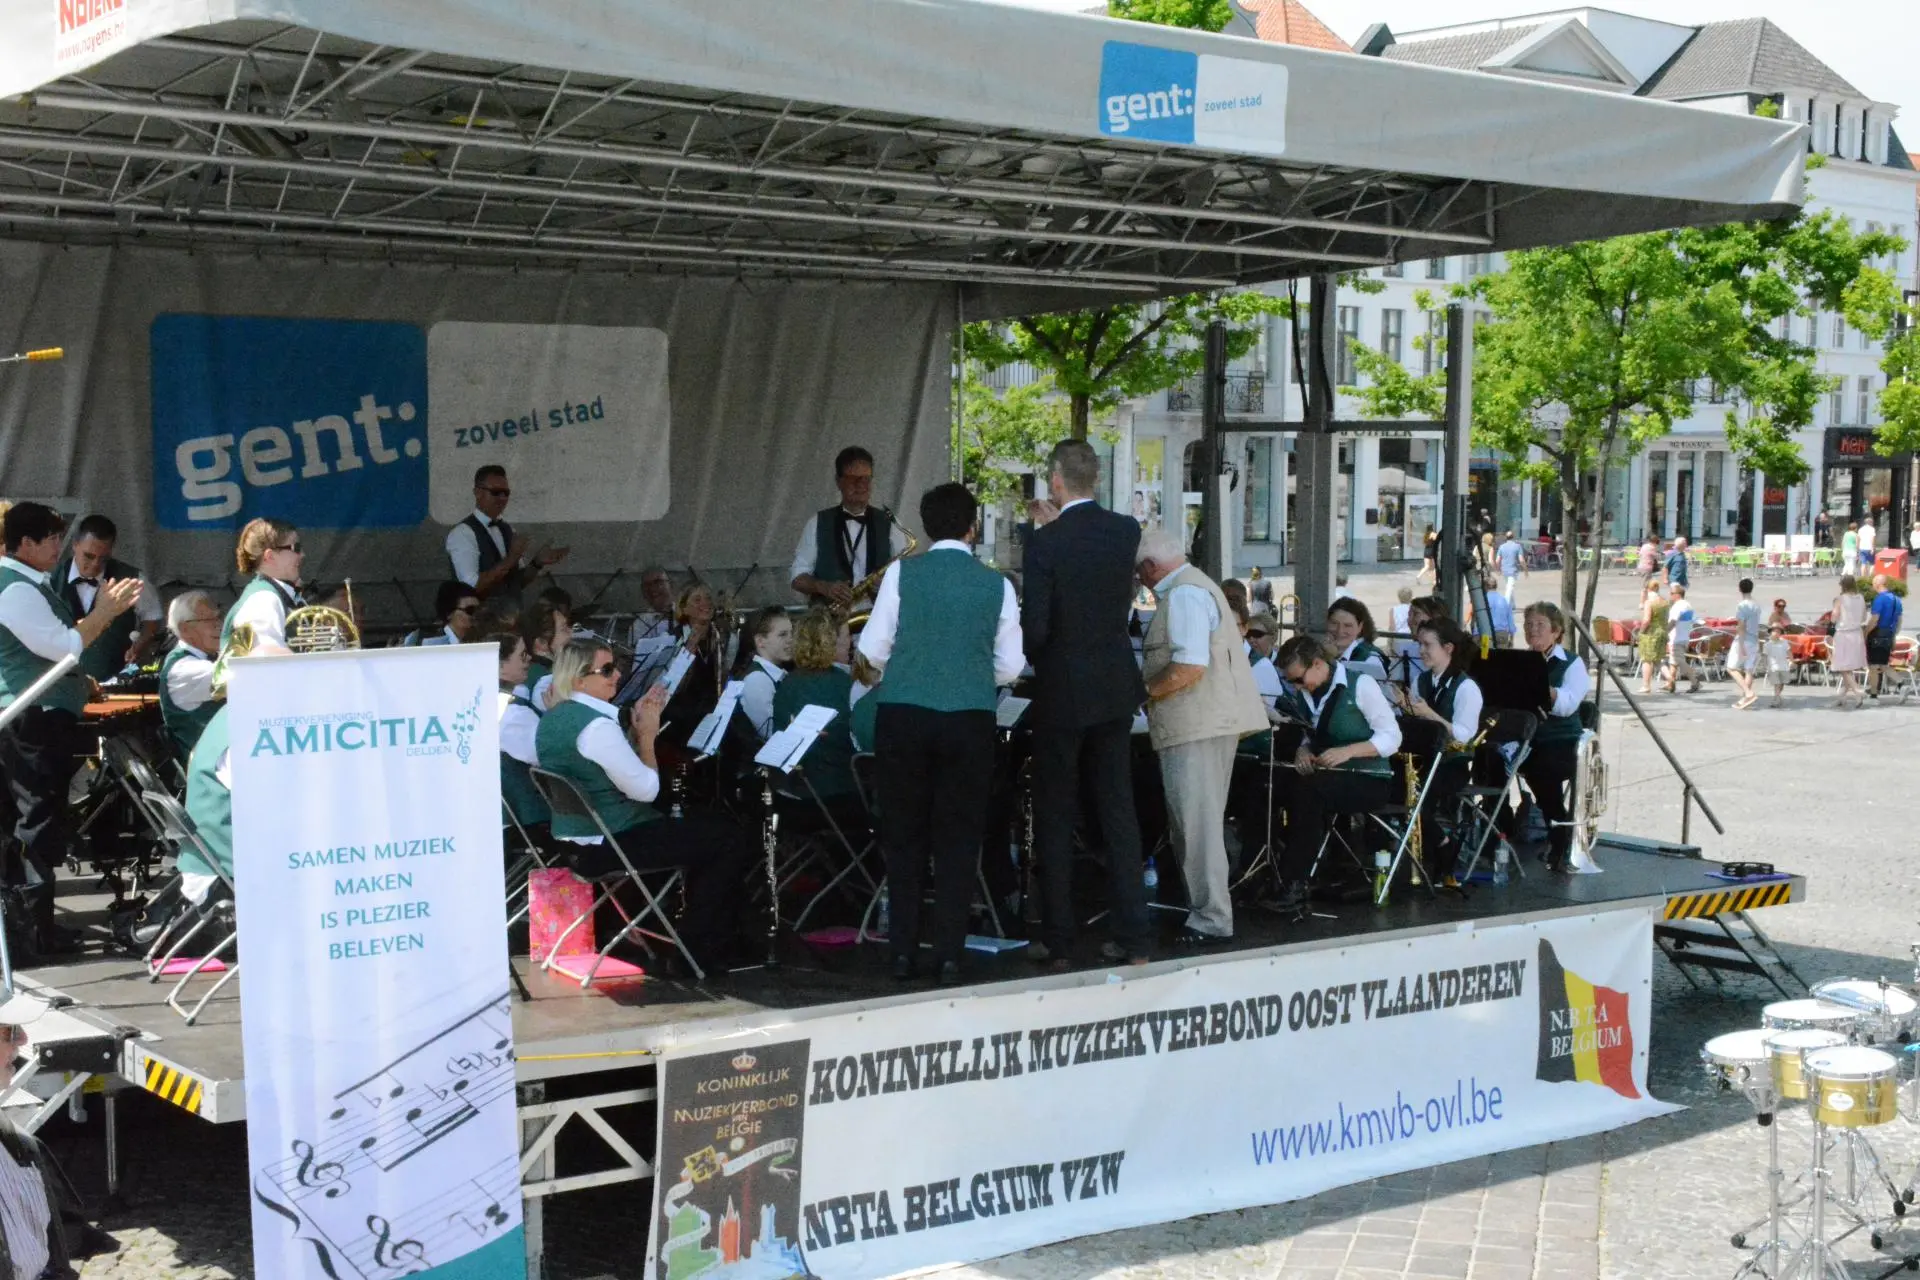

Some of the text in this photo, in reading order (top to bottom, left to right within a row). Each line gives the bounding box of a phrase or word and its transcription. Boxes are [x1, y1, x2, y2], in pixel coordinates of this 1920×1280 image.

[1106, 83, 1193, 133] gent:
[1204, 93, 1262, 112] zoveel stad
[453, 395, 604, 449] zoveel stad
[175, 393, 423, 521] gent:
[258, 711, 374, 728] MUZIEKVERENIGING
[250, 715, 450, 757] AMICITIA
[406, 745, 452, 757] DELDEN
[288, 836, 456, 869] SAMEN MUZIEK
[334, 872, 413, 896] MAKEN
[321, 901, 431, 930] IS PLEZIER
[329, 933, 424, 960] BELEVEN
[809, 1030, 1023, 1106] KONINKLIJK
[1288, 983, 1357, 1031] OOST
[1361, 959, 1527, 1021] VLAANDEREN
[1550, 1026, 1623, 1058] BELGIUM
[696, 1067, 790, 1094] KONINKLIJK
[674, 1093, 799, 1122] MUZIEKVERBOND
[1252, 1077, 1503, 1165] www.kmvb-ovl.be
[803, 1150, 1125, 1252] NBTA BELGIUM VZW
